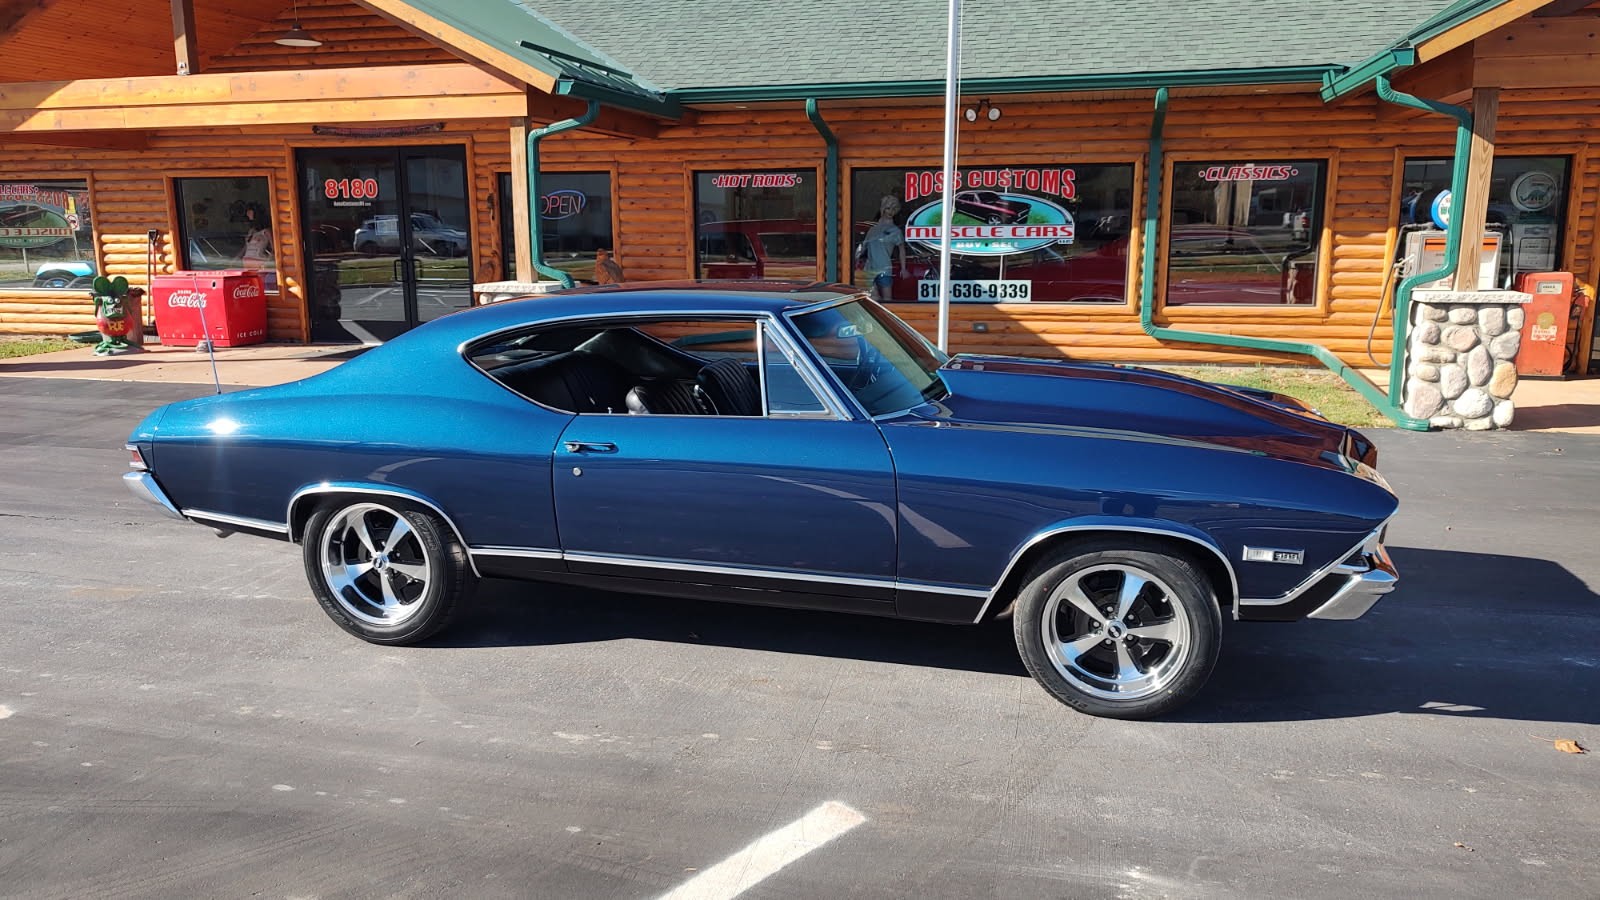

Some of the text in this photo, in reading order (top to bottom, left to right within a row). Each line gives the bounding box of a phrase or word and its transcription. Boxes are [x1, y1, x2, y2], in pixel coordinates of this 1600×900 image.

[717, 174, 797, 188] HOT RODS
[1205, 166, 1292, 181] CLASSICS
[325, 179, 378, 198] 8180
[967, 169, 1076, 199] CUSTOMS
[541, 195, 582, 215] OPEN
[1011, 226, 1073, 237] CARS
[920, 283, 1028, 298] 81-636-9339
